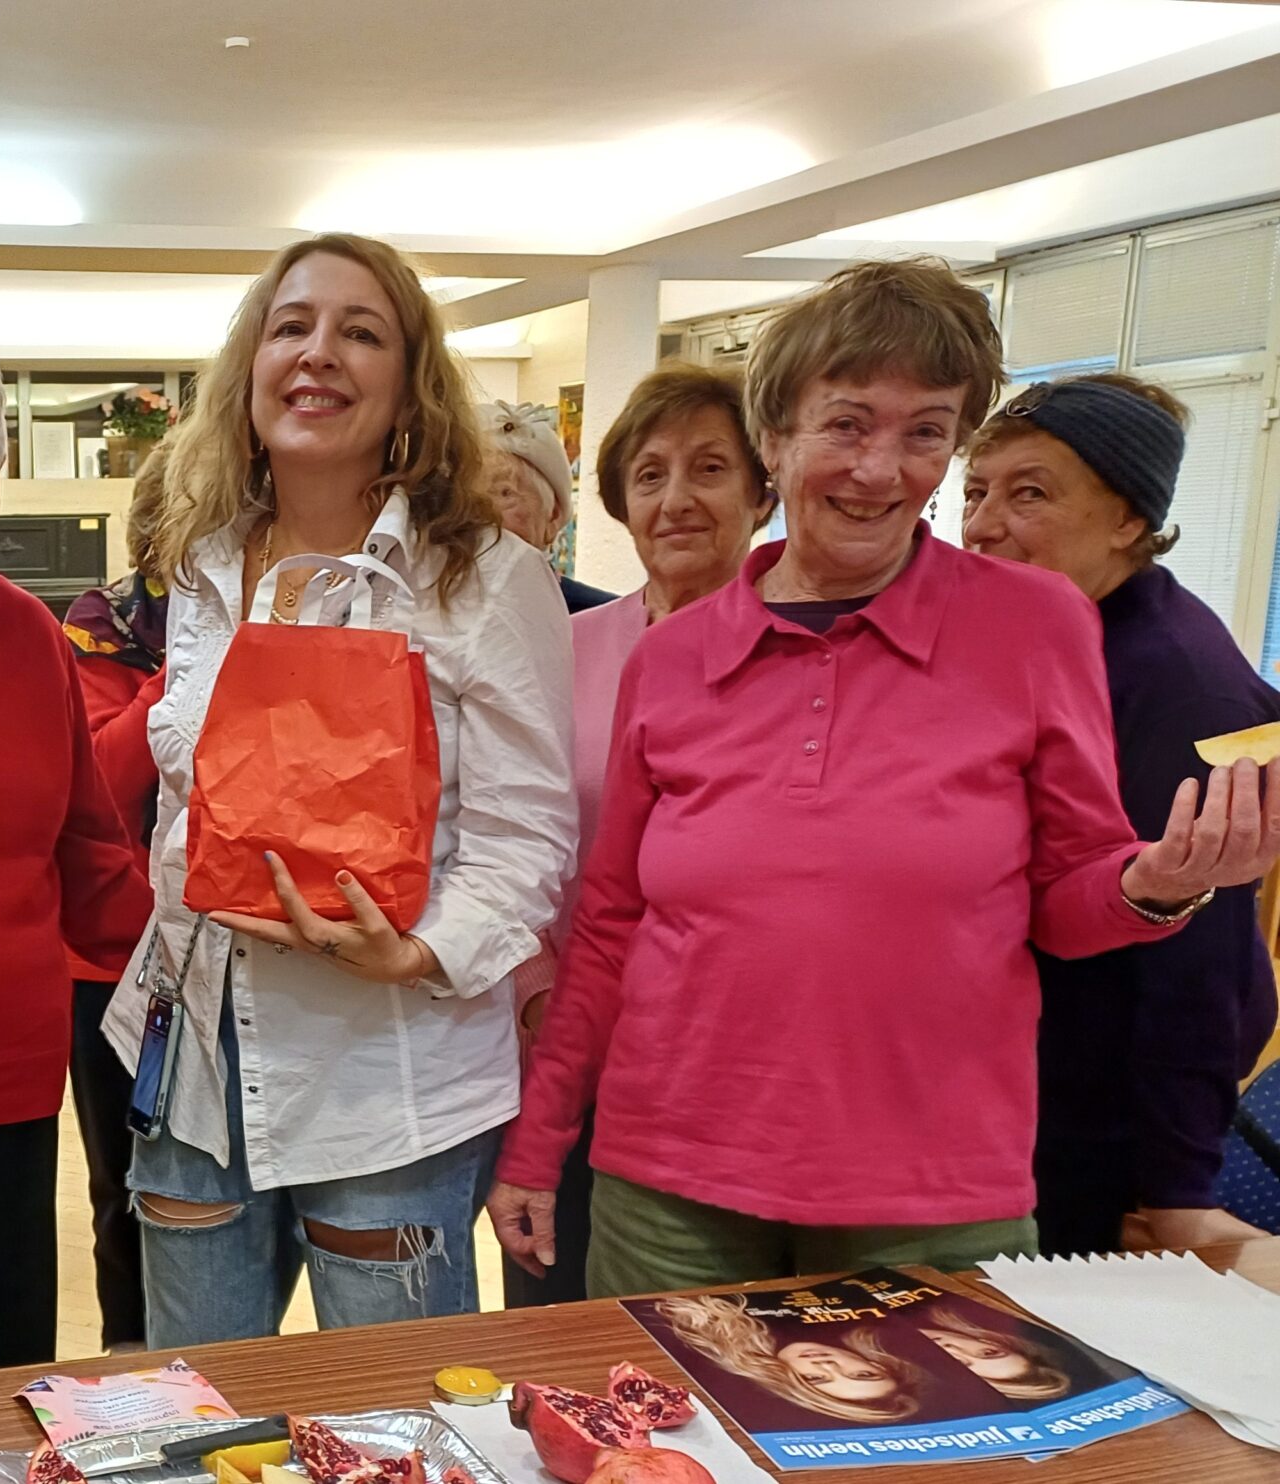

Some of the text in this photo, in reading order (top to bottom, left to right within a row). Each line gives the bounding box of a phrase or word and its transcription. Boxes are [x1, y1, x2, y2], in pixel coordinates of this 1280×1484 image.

[800, 1308, 886, 1324] LICHT
[1069, 1386, 1177, 1431] jüdisches
[780, 1441, 871, 1458] berlin
[873, 1425, 1011, 1456] jüdisches
